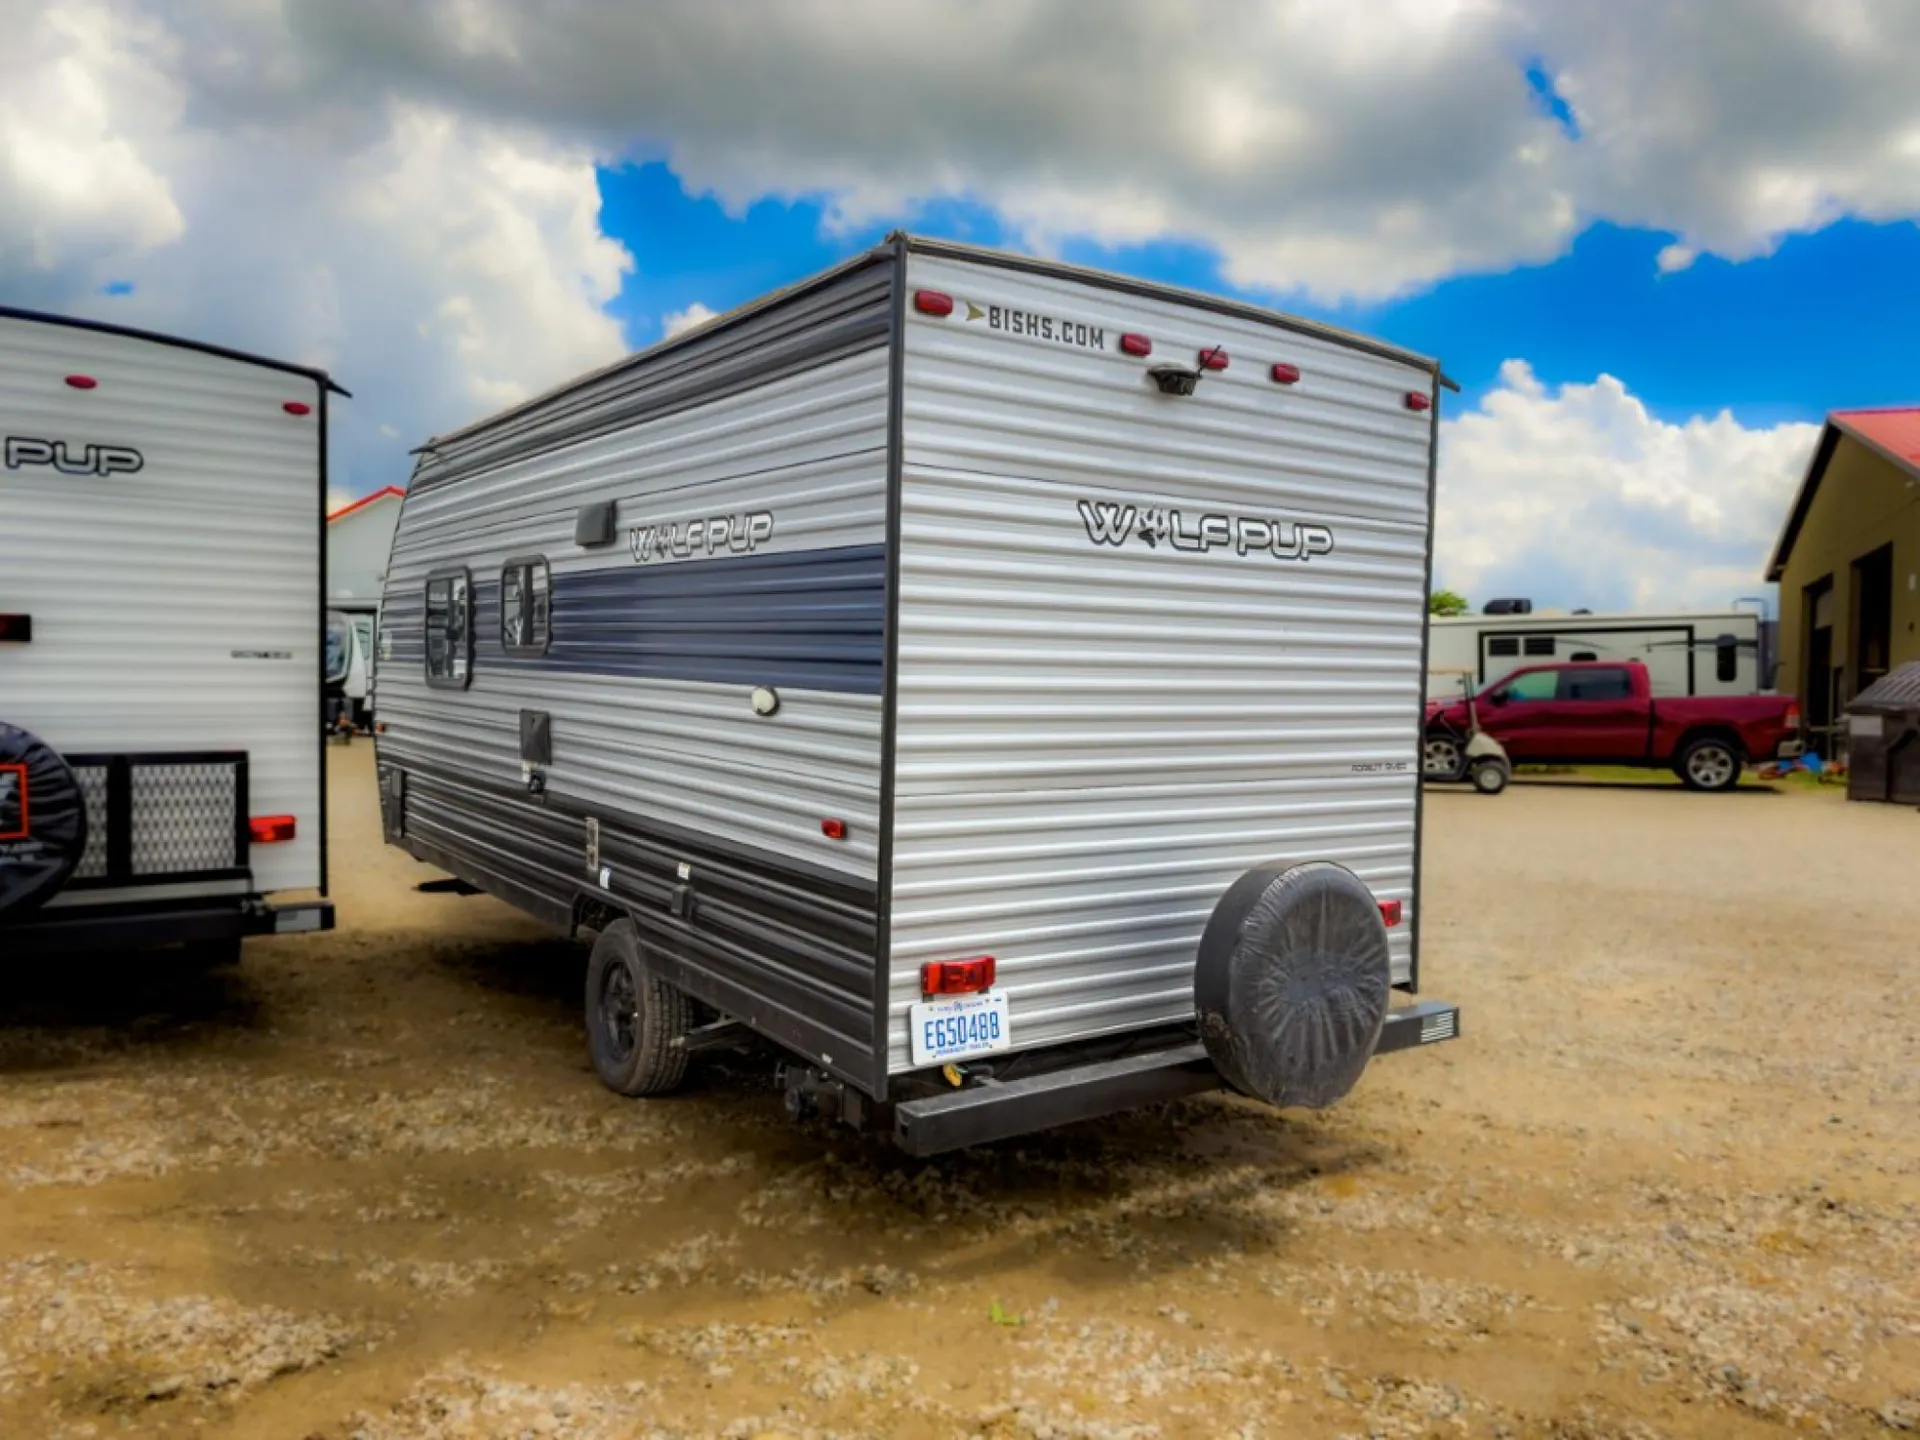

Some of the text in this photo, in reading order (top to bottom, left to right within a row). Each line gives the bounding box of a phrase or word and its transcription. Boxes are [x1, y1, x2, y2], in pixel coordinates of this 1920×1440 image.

[989, 304, 1104, 350] BISHS.COM
[5, 436, 144, 477] PUP
[707, 510, 774, 555] PUP
[1236, 517, 1334, 561] PUP
[924, 1011, 1000, 1050] E650488
